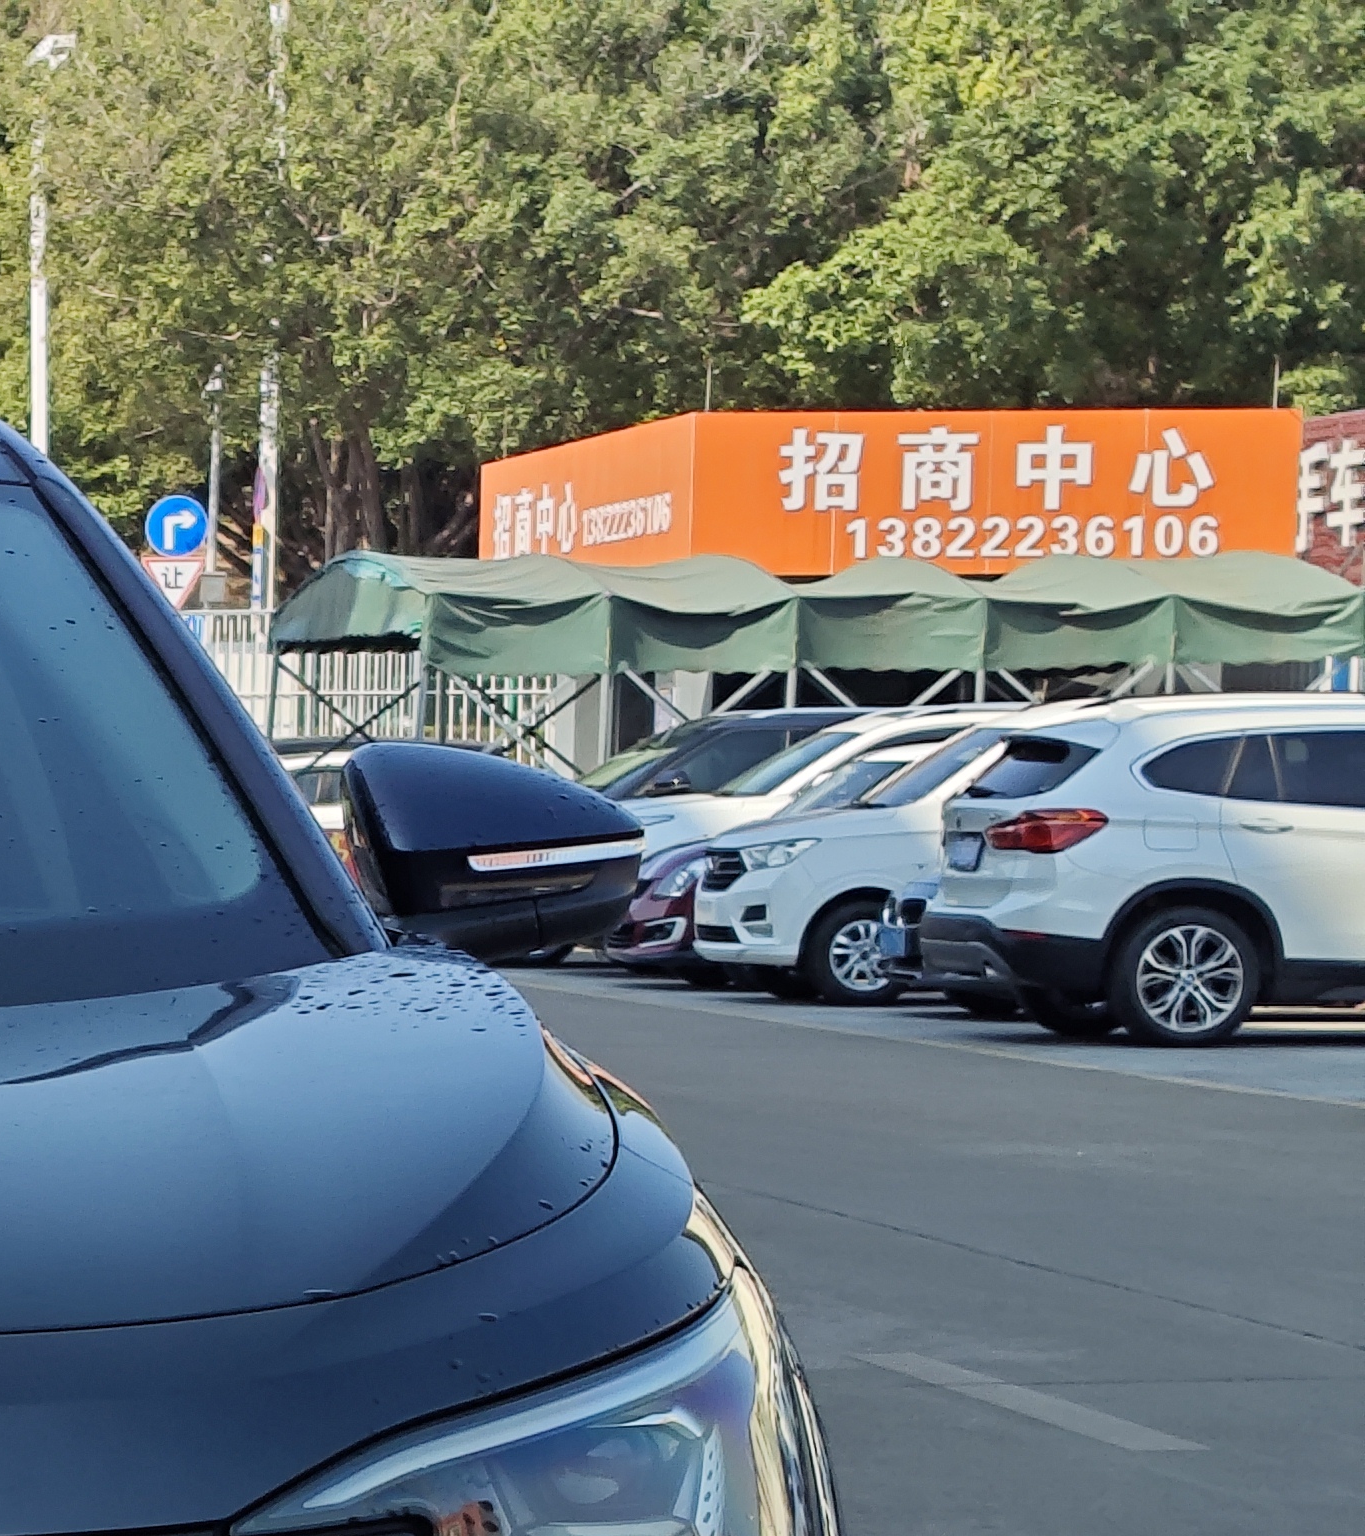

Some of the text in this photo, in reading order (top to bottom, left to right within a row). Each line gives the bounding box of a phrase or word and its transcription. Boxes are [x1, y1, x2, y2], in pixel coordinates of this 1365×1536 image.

[779, 424, 1215, 512] 招商中心
[493, 481, 672, 560] 招商中心 13822236106
[846, 515, 1219, 559] 13822236106
[161, 566, 183, 588] 让
